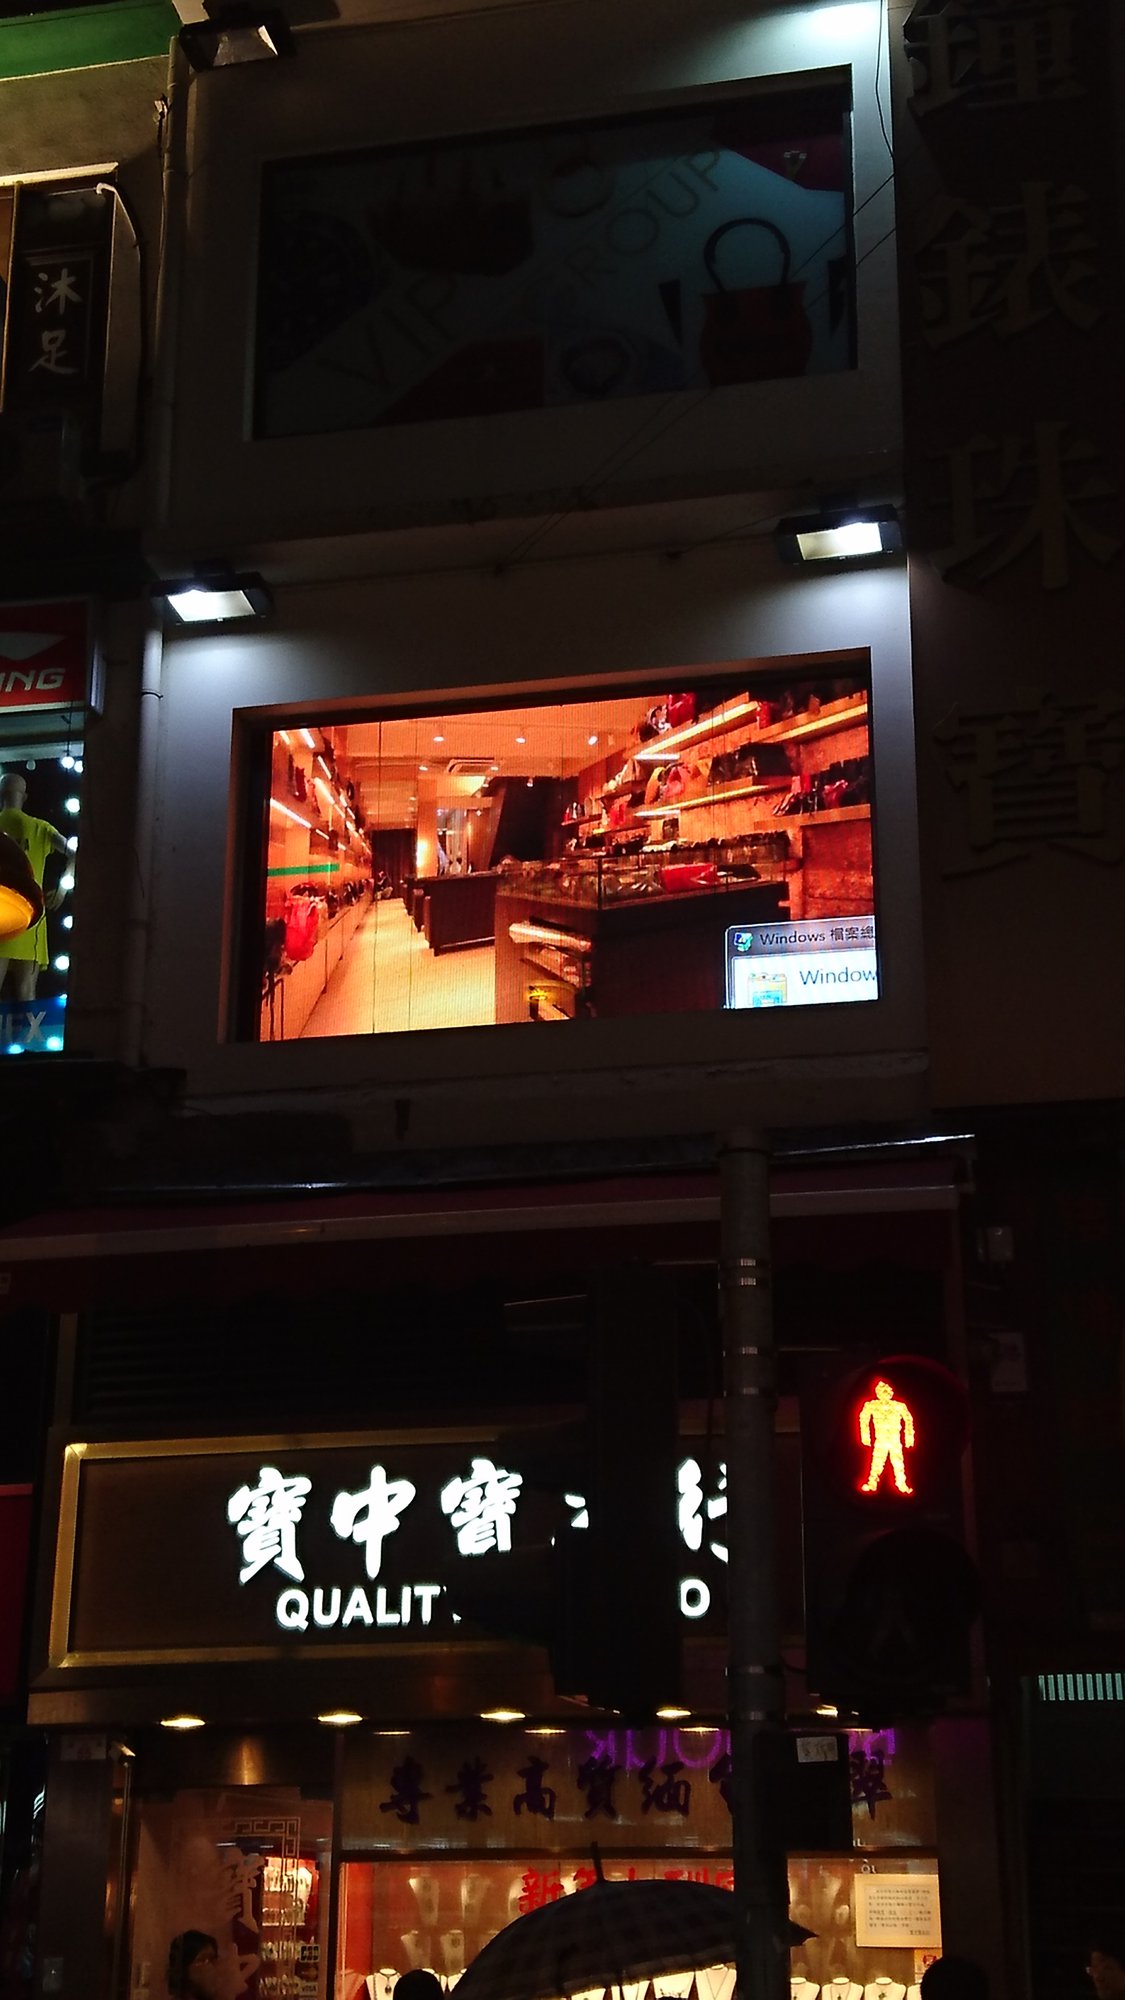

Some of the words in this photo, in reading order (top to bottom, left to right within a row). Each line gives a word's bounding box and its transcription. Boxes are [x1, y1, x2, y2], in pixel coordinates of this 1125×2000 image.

[28, 267, 84, 375] 沐足
[317, 273, 459, 390] VIP
[760, 931, 826, 945] Windows
[276, 1584, 463, 1632] QUALIT
